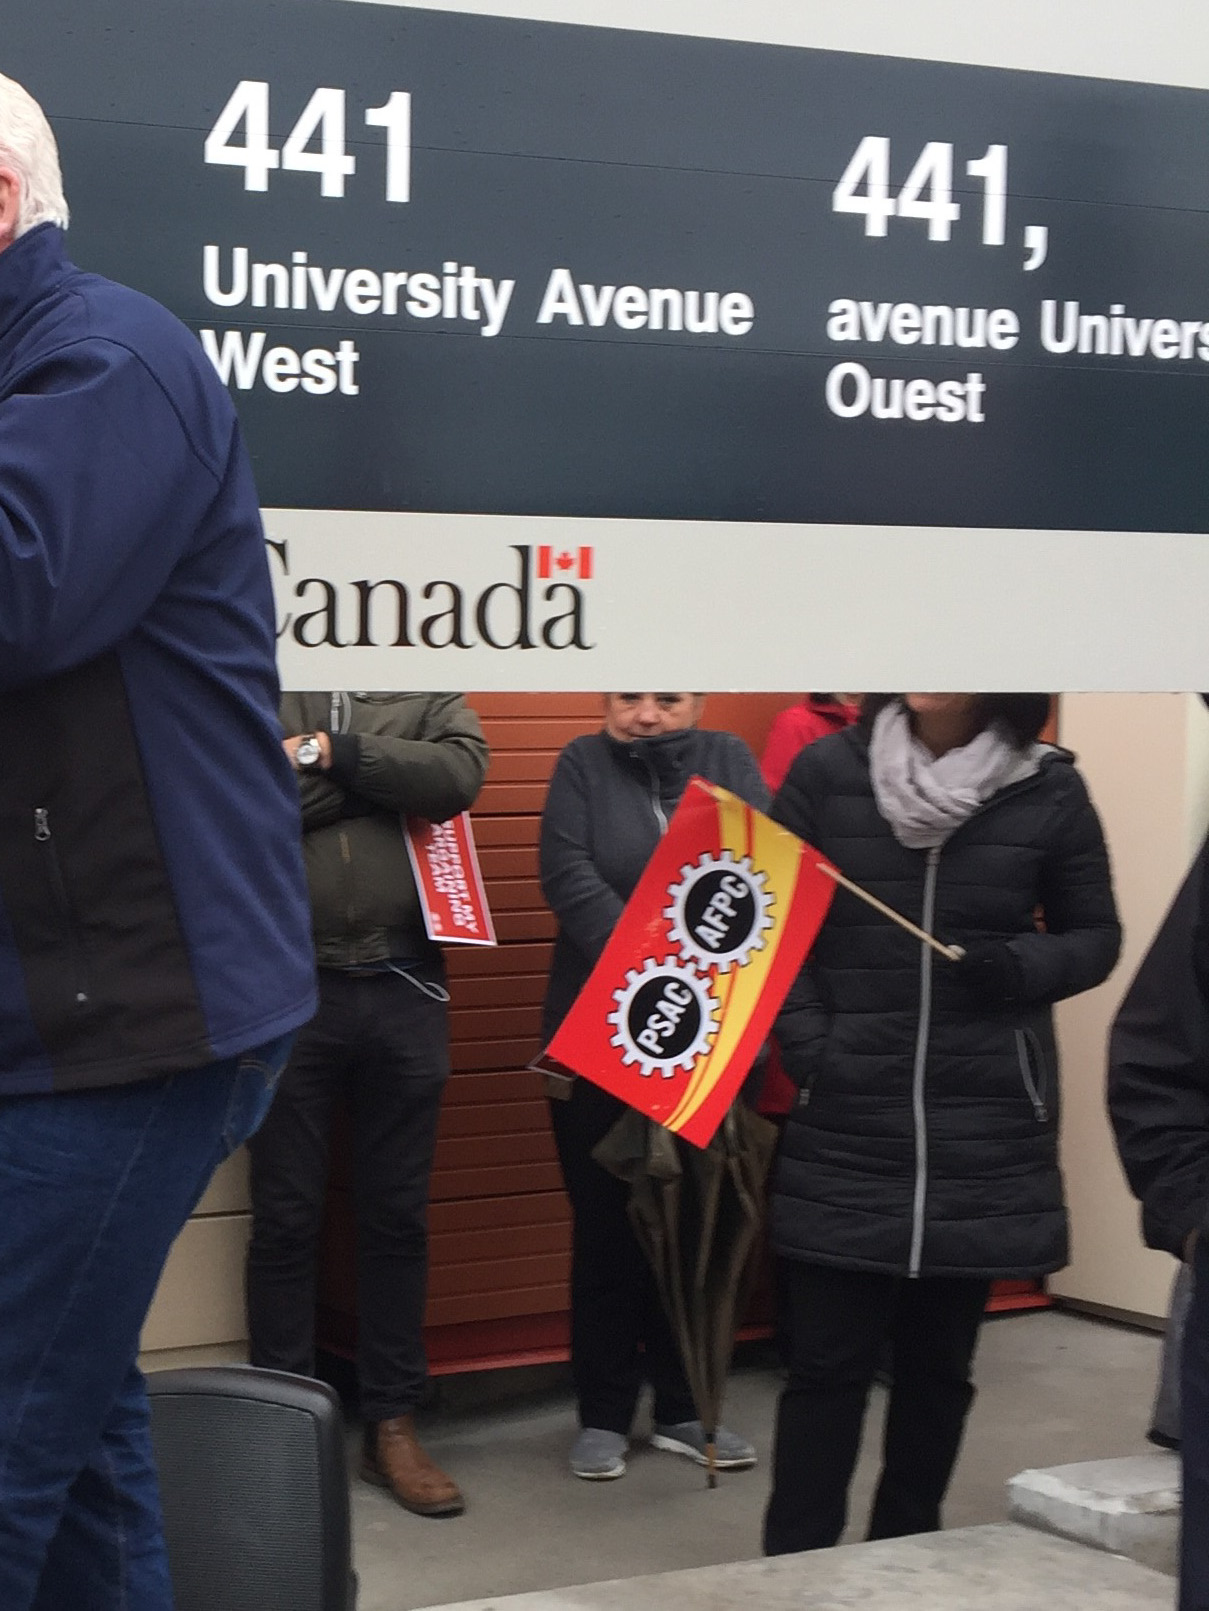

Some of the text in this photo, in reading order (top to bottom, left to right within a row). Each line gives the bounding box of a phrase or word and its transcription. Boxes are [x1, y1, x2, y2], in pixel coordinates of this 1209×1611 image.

[204, 80, 411, 202] 441
[831, 136, 1049, 271] 441,
[202, 244, 755, 337] University Avenue
[826, 298, 1020, 350] avenue
[200, 328, 360, 395] West
[825, 361, 987, 423] Ouest
[694, 875, 750, 949] AFPC
[636, 981, 694, 1055] PSAC
